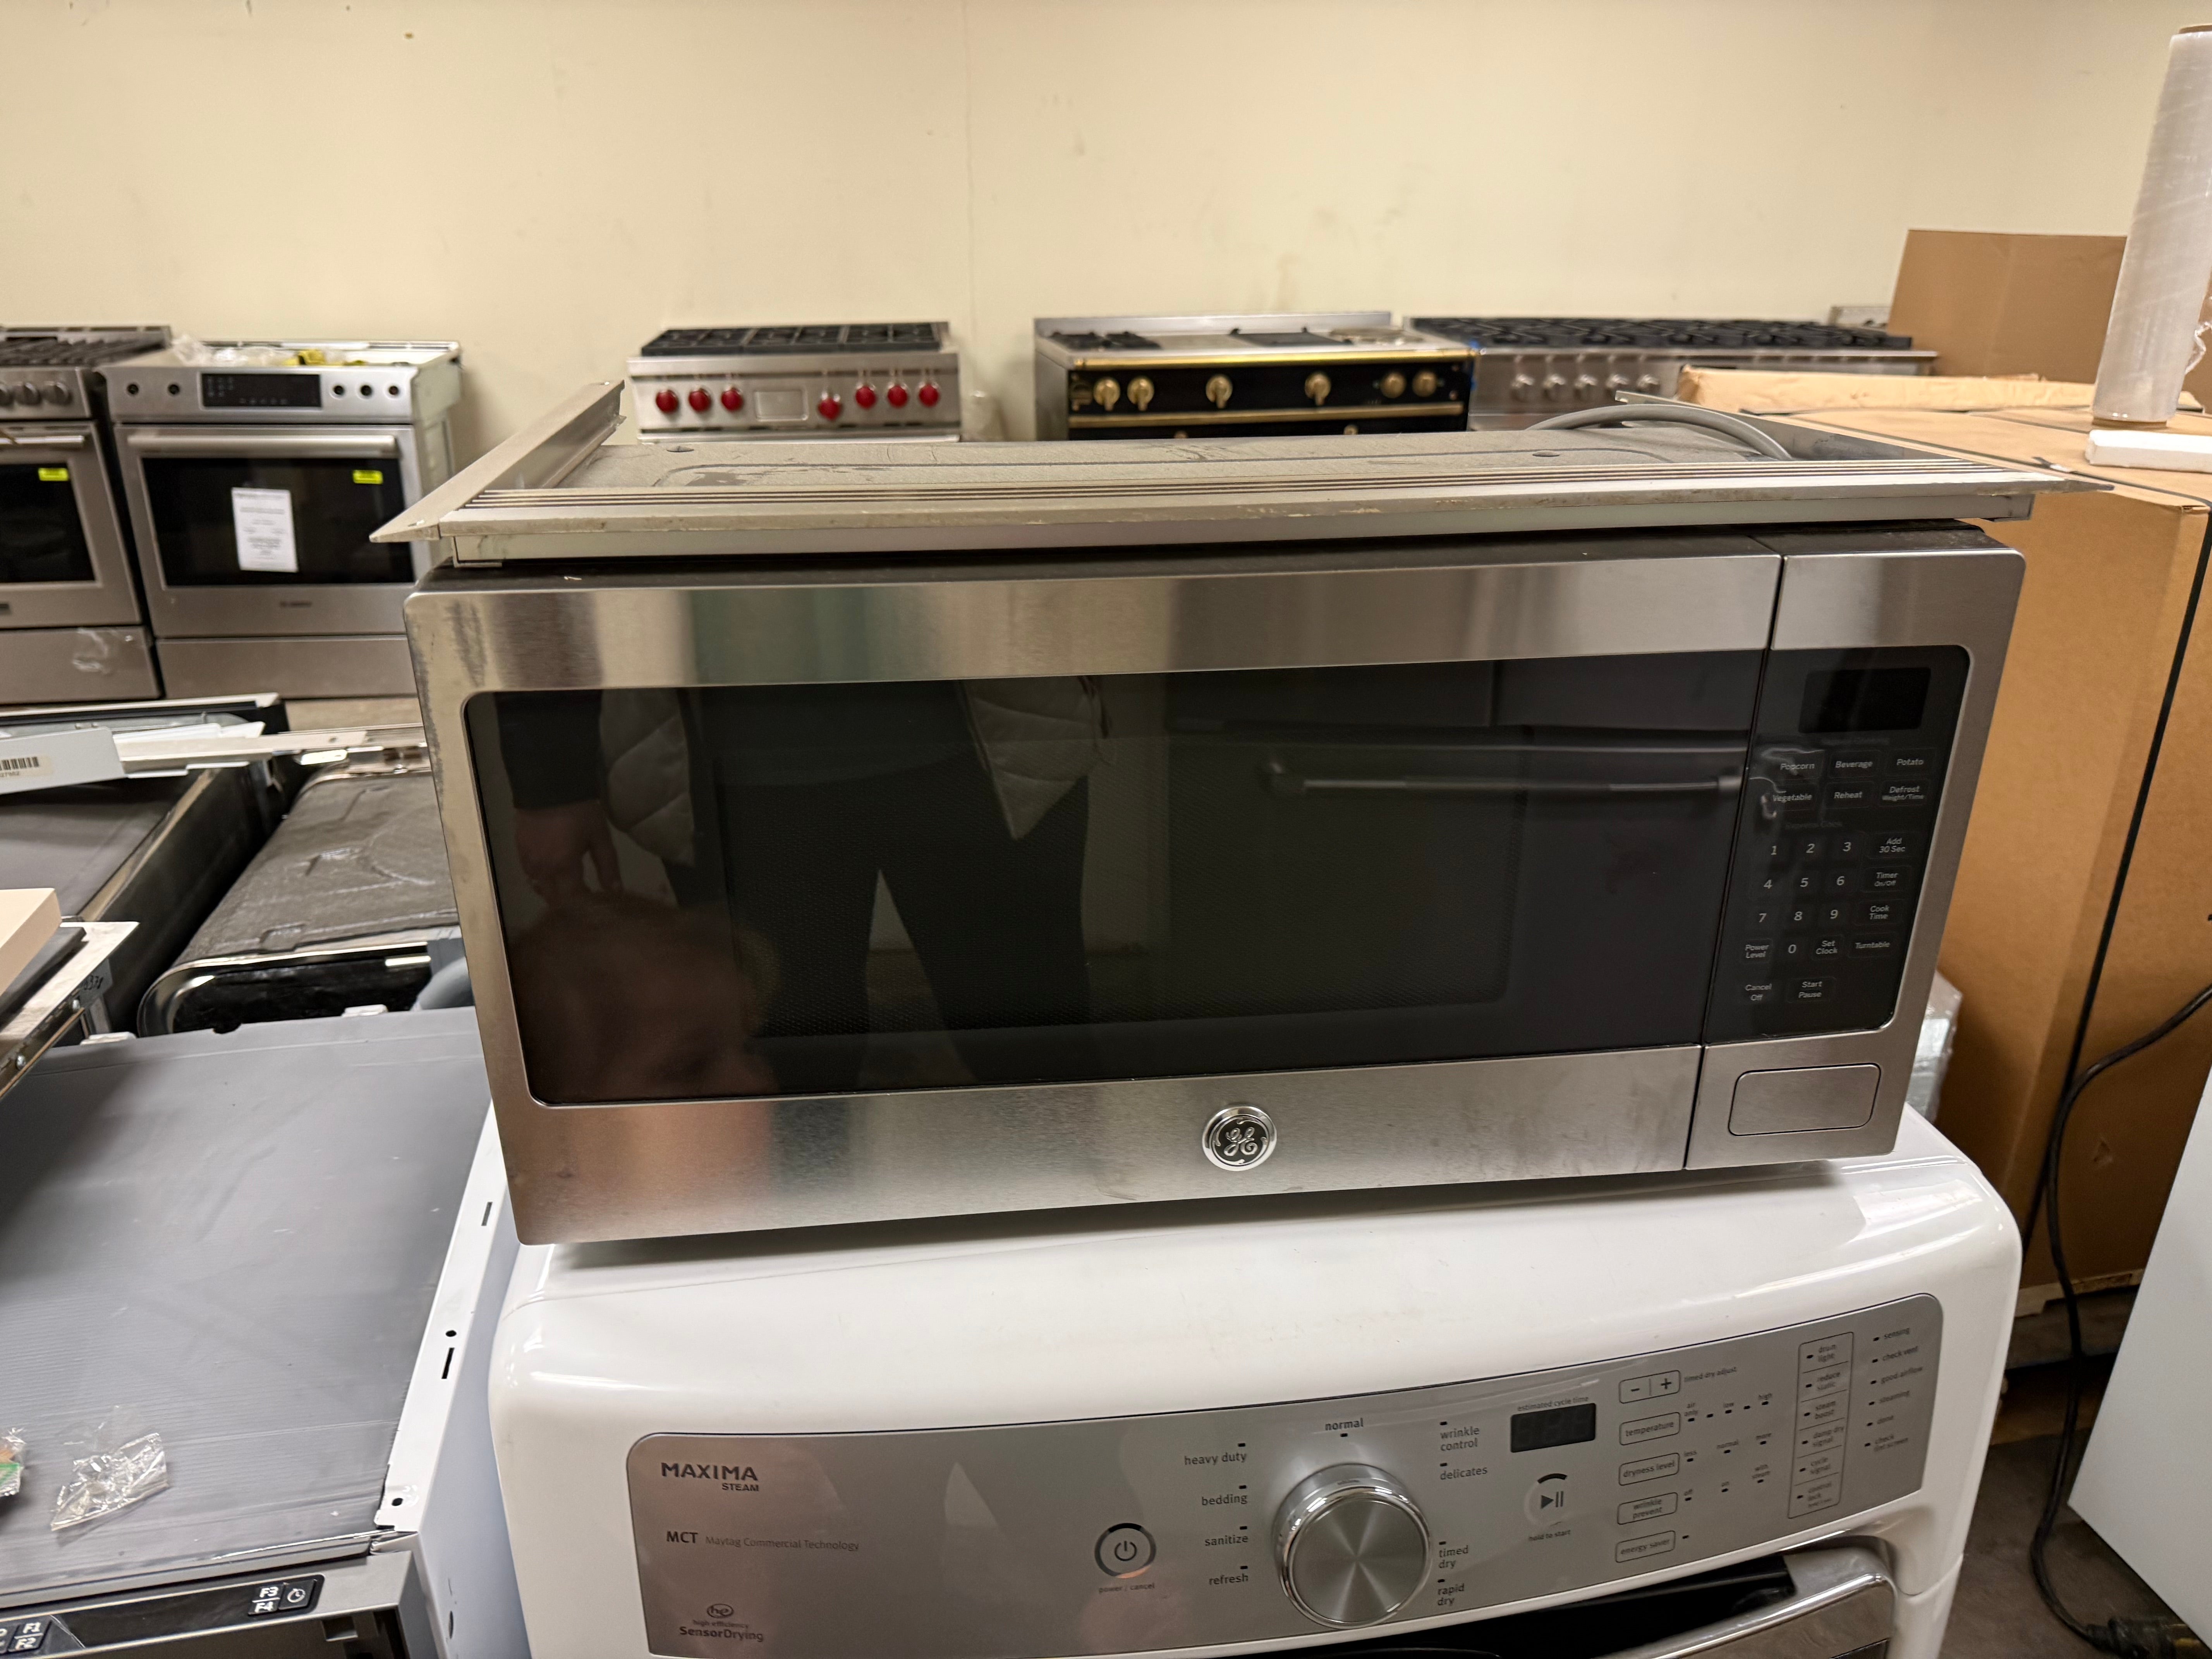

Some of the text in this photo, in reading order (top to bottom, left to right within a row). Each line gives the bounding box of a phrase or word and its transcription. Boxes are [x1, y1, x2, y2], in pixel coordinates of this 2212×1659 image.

[1835, 761, 1873, 769] Beverage
[1773, 794, 1813, 803] Vegetable
[1771, 845, 1777, 855] 1
[1806, 843, 1815, 854] 2
[1842, 842, 1852, 852] 3
[1764, 879, 1772, 889] 4
[1800, 878, 1809, 887] 5
[1836, 876, 1845, 886] 6
[1759, 913, 1767, 923] 7
[1793, 911, 1803, 921] 8
[1830, 909, 1838, 919] 9
[1788, 944, 1797, 954] 0
[1884, 1328, 1910, 1339] sensing
[1882, 1350, 1902, 1361] check
[1517, 1396, 1589, 1412] estimated cycle time
[1325, 1418, 1364, 1431] normal
[1625, 1421, 1675, 1437] temperature
[1440, 1427, 1480, 1439] wrinkle
[1441, 1438, 1478, 1451] control
[1184, 1452, 1247, 1466] heavy duty
[661, 1462, 759, 1481] MAXIMA
[1440, 1466, 1488, 1480] delicates
[1623, 1460, 1675, 1478] dryness level
[721, 1482, 760, 1492] STEAM
[1201, 1494, 1248, 1506] bedding
[1632, 1506, 1662, 1520] prevent
[666, 1530, 860, 1551] MCT Maytag Commercial Technology
[1205, 1534, 1249, 1547] sanitize
[1528, 1532, 1544, 1541] hold
[1439, 1545, 1469, 1558] timed
[1438, 1558, 1456, 1569] dry
[1209, 1573, 1249, 1585] refresh
[259, 1586, 279, 1598] F3
[1098, 1585, 1123, 1594] power
[1130, 1582, 1155, 1591] cancel
[1437, 1583, 1465, 1596] rapid
[254, 1601, 274, 1613] F4
[1437, 1596, 1455, 1607] dry
[23, 1622, 41, 1634] F1
[679, 1626, 764, 1642] SensorDrying
[15, 1637, 36, 1650] F2
